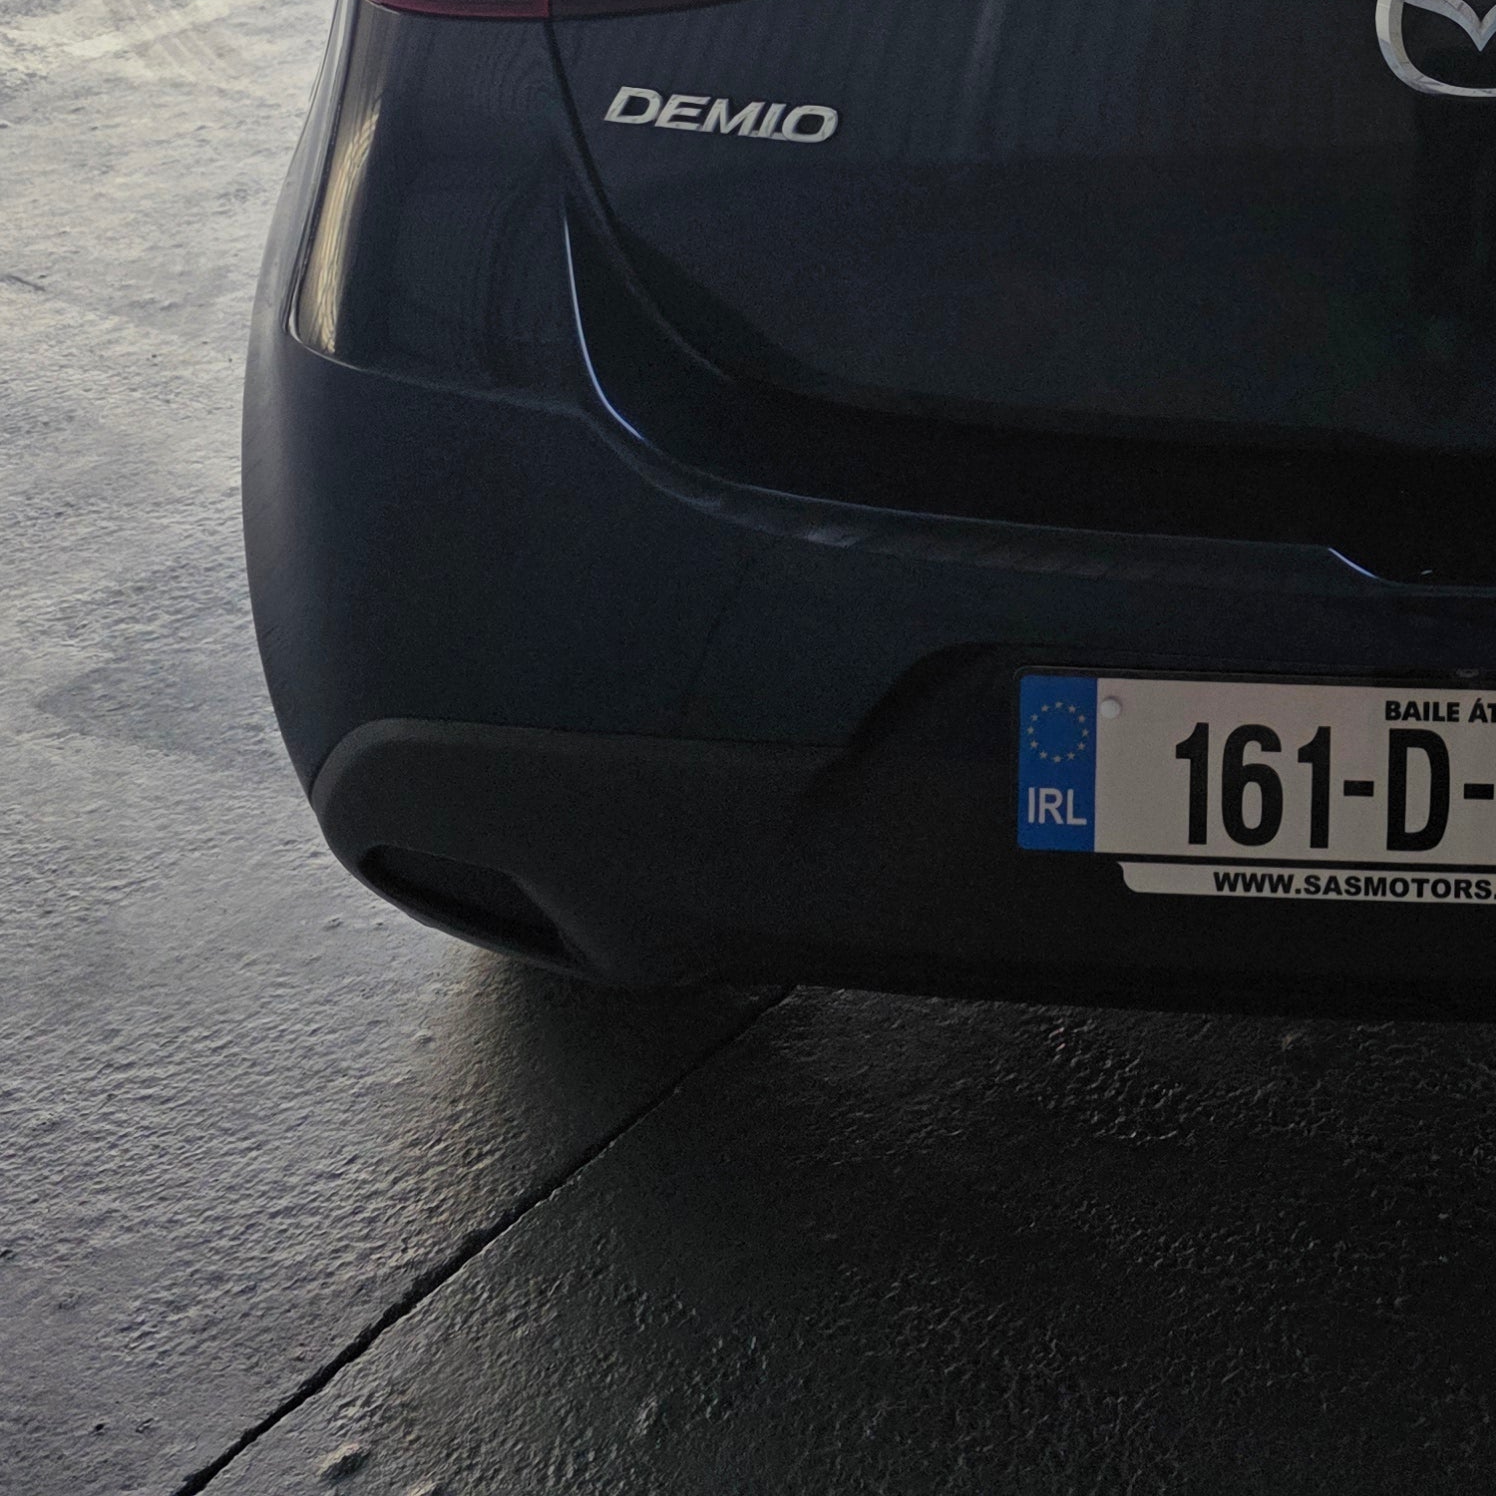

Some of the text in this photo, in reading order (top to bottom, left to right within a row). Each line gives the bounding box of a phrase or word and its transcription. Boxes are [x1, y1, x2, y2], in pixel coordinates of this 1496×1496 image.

[603, 85, 839, 144] DEMIO
[1384, 700, 1461, 723] BAILE
[1027, 786, 1088, 826] IRL
